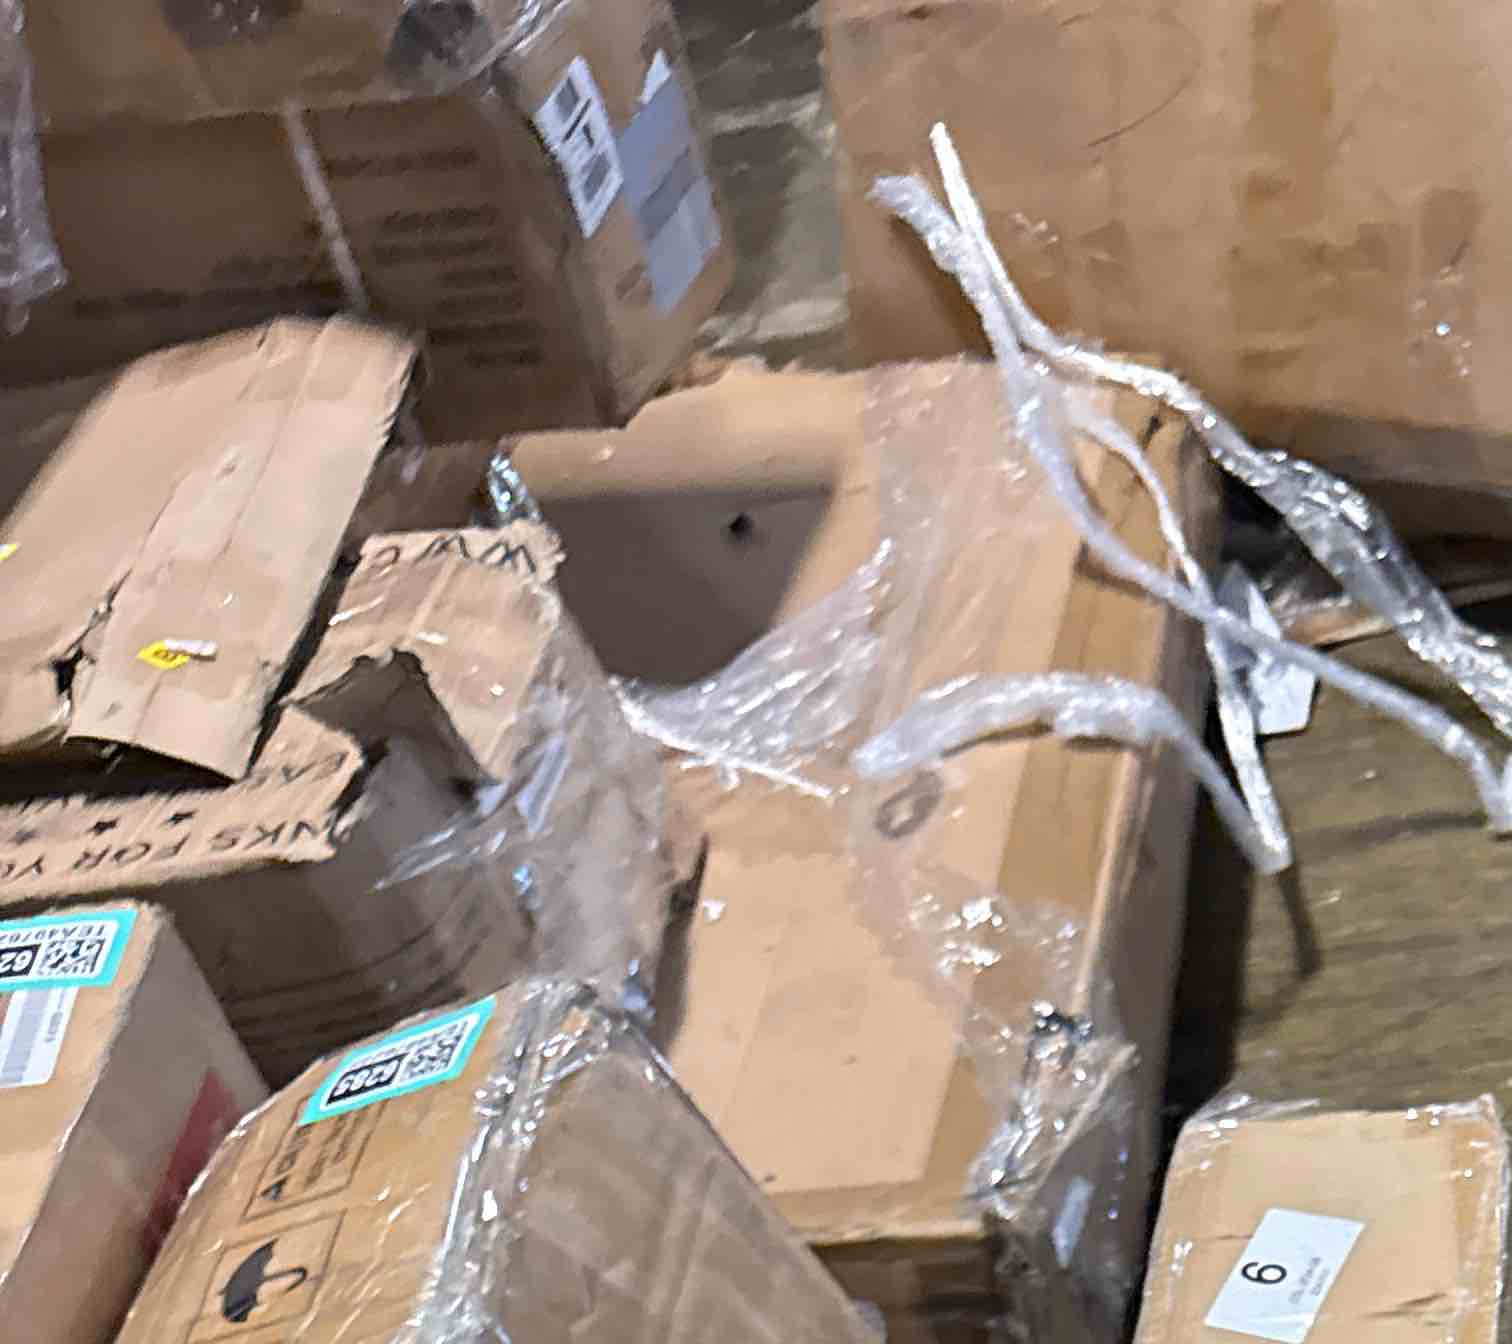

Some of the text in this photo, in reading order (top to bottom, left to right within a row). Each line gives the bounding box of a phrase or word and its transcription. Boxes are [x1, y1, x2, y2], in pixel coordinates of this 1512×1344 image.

[207, 817, 332, 854] NKS
[72, 834, 191, 881] FOR
[1239, 1261, 1288, 1285] 6
